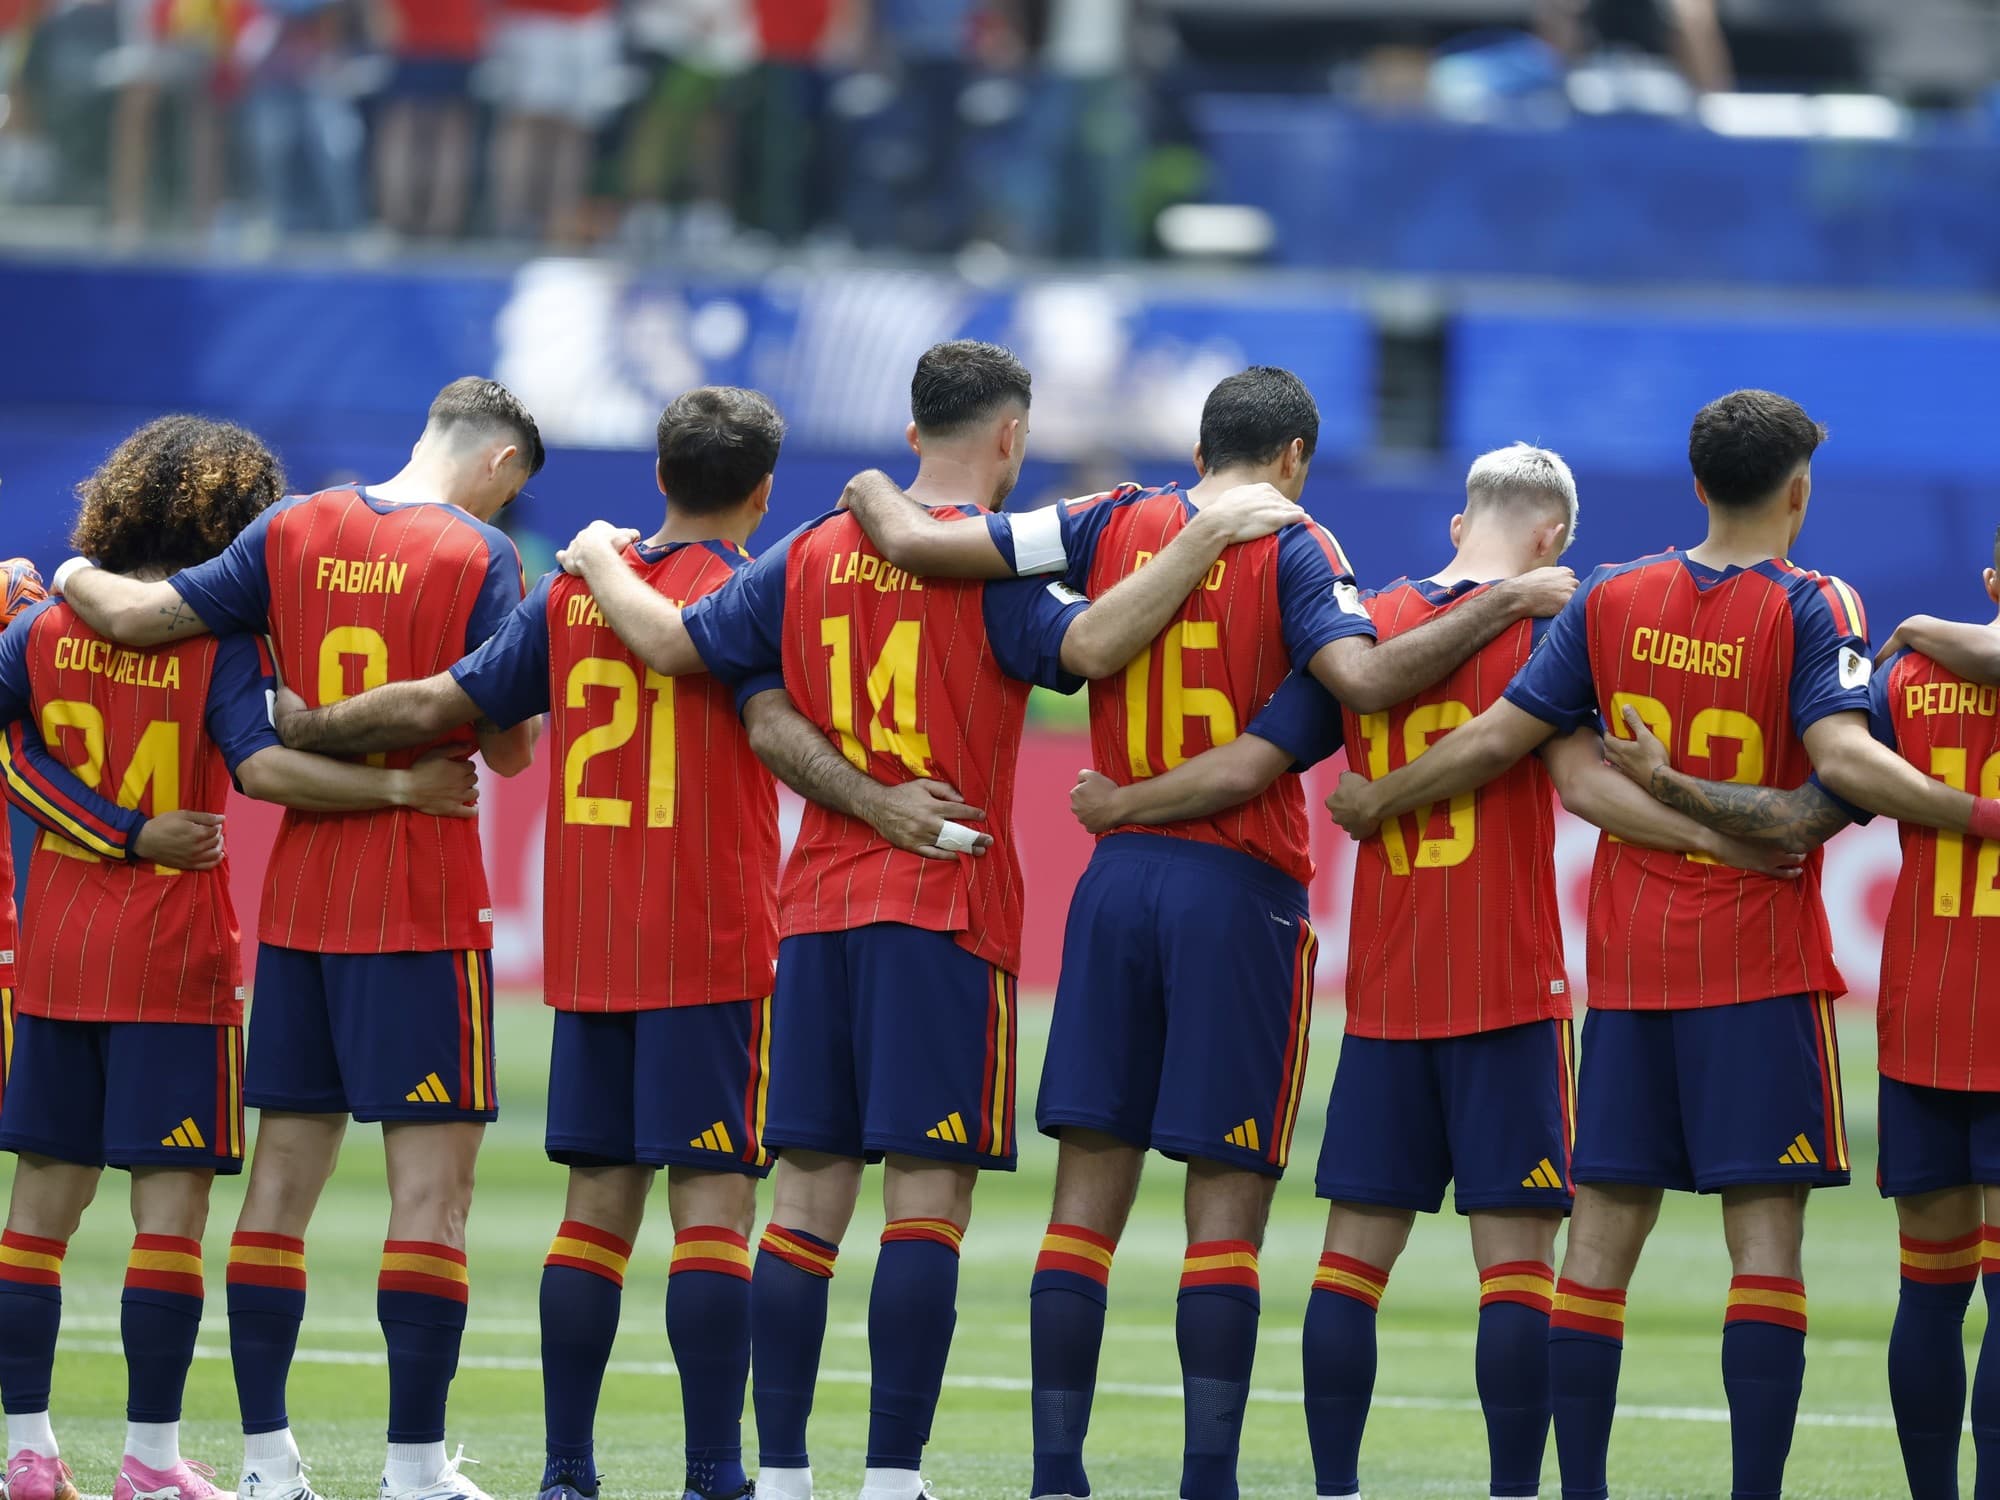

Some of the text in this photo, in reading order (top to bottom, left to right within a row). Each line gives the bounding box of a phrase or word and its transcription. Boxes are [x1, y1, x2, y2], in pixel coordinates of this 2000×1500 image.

[316, 553, 407, 595] FABIÁN
[54, 637, 180, 690] CUCURELLA
[821, 614, 932, 778] 14
[1126, 620, 1237, 778] 16
[1631, 627, 1744, 680] CUBARSÍ
[1904, 682, 1998, 719] PEDRO
[41, 698, 182, 876] 24
[564, 657, 678, 829] 21
